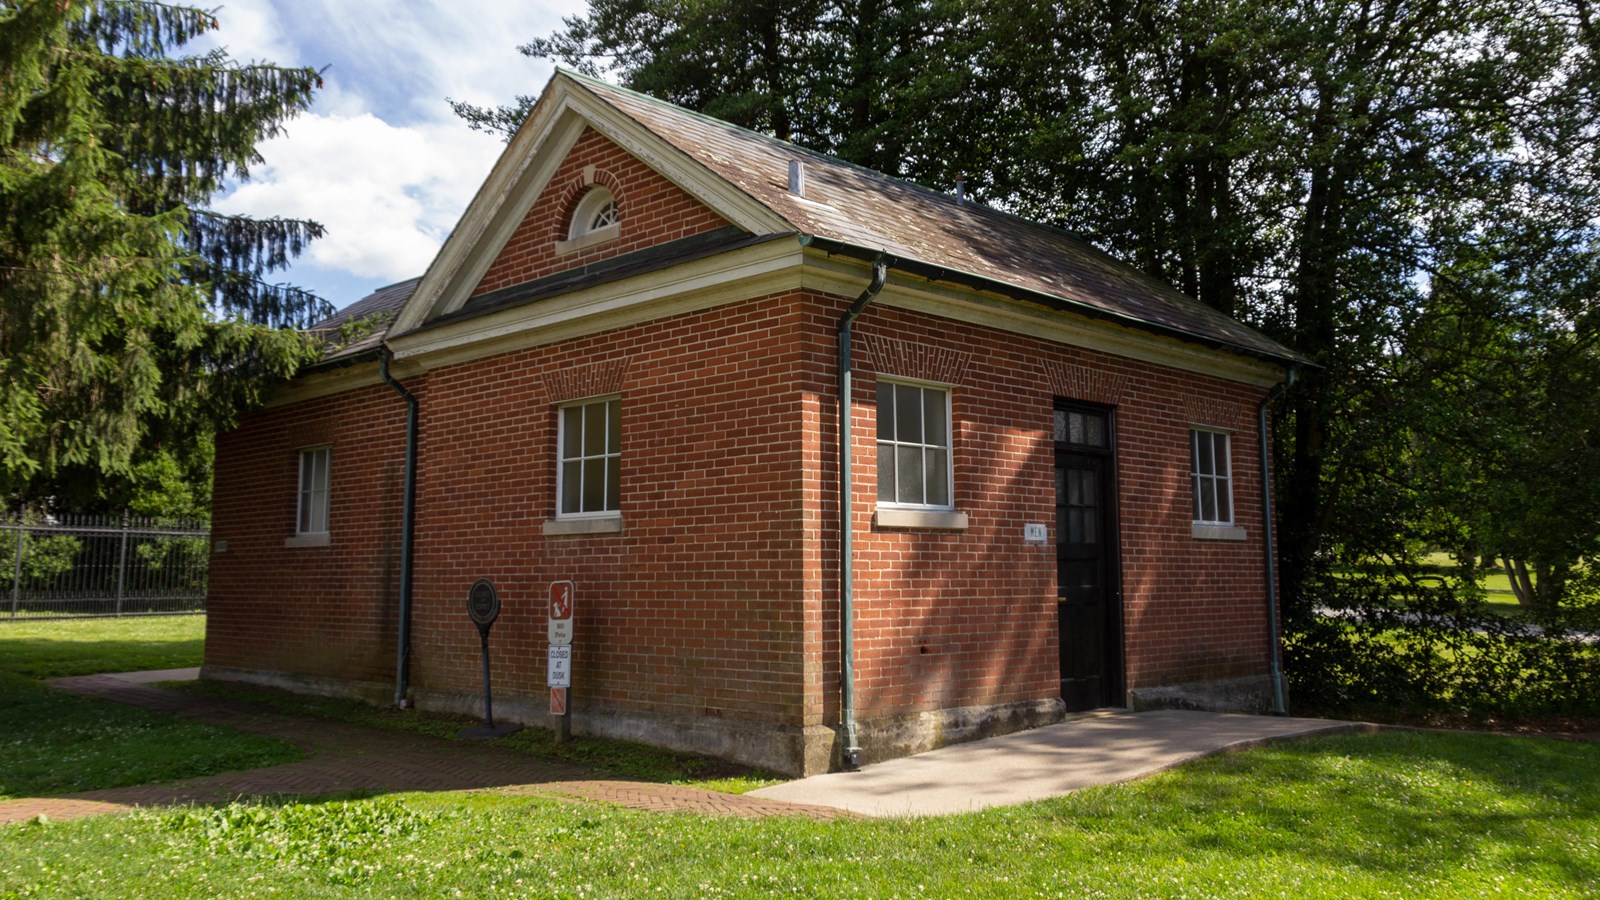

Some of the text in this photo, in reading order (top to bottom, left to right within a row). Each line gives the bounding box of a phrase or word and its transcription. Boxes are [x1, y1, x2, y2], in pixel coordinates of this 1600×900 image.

[1030, 526, 1043, 538] MEN
[550, 650, 569, 659] CLOSED
[556, 661, 562, 669] AT
[552, 671, 565, 680] DUSK
